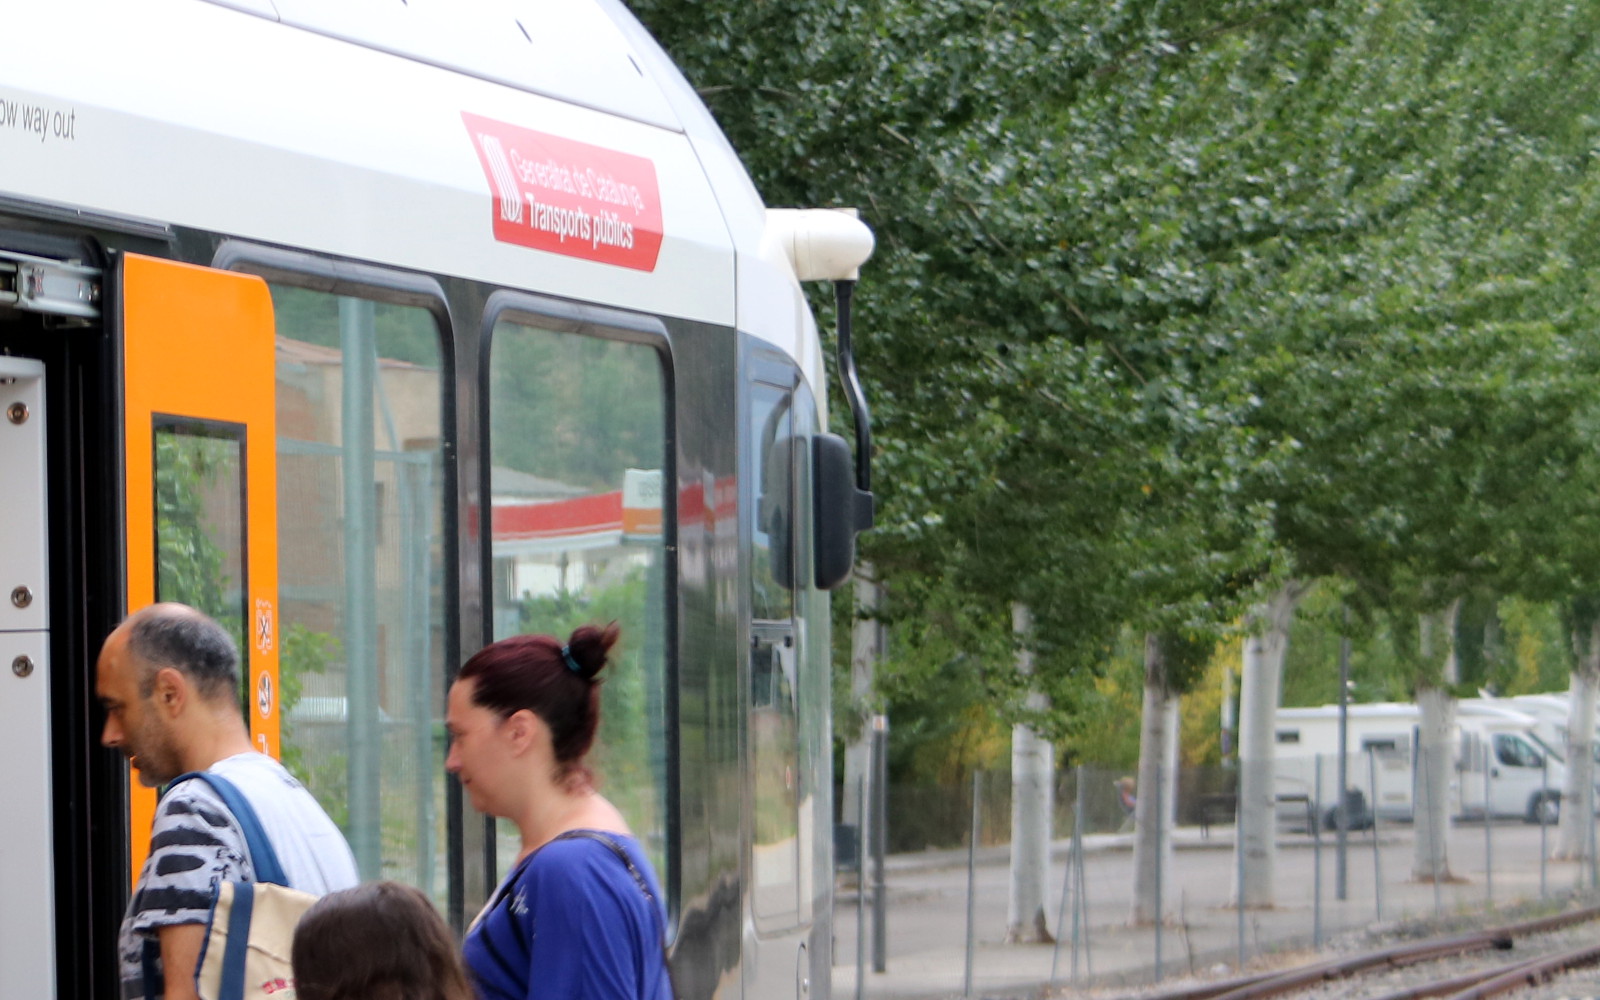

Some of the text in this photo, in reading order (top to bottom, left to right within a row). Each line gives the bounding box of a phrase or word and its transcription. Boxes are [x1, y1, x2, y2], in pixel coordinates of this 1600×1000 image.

[22, 103, 50, 144] way
[53, 107, 76, 140] out
[525, 192, 591, 243] Transports
